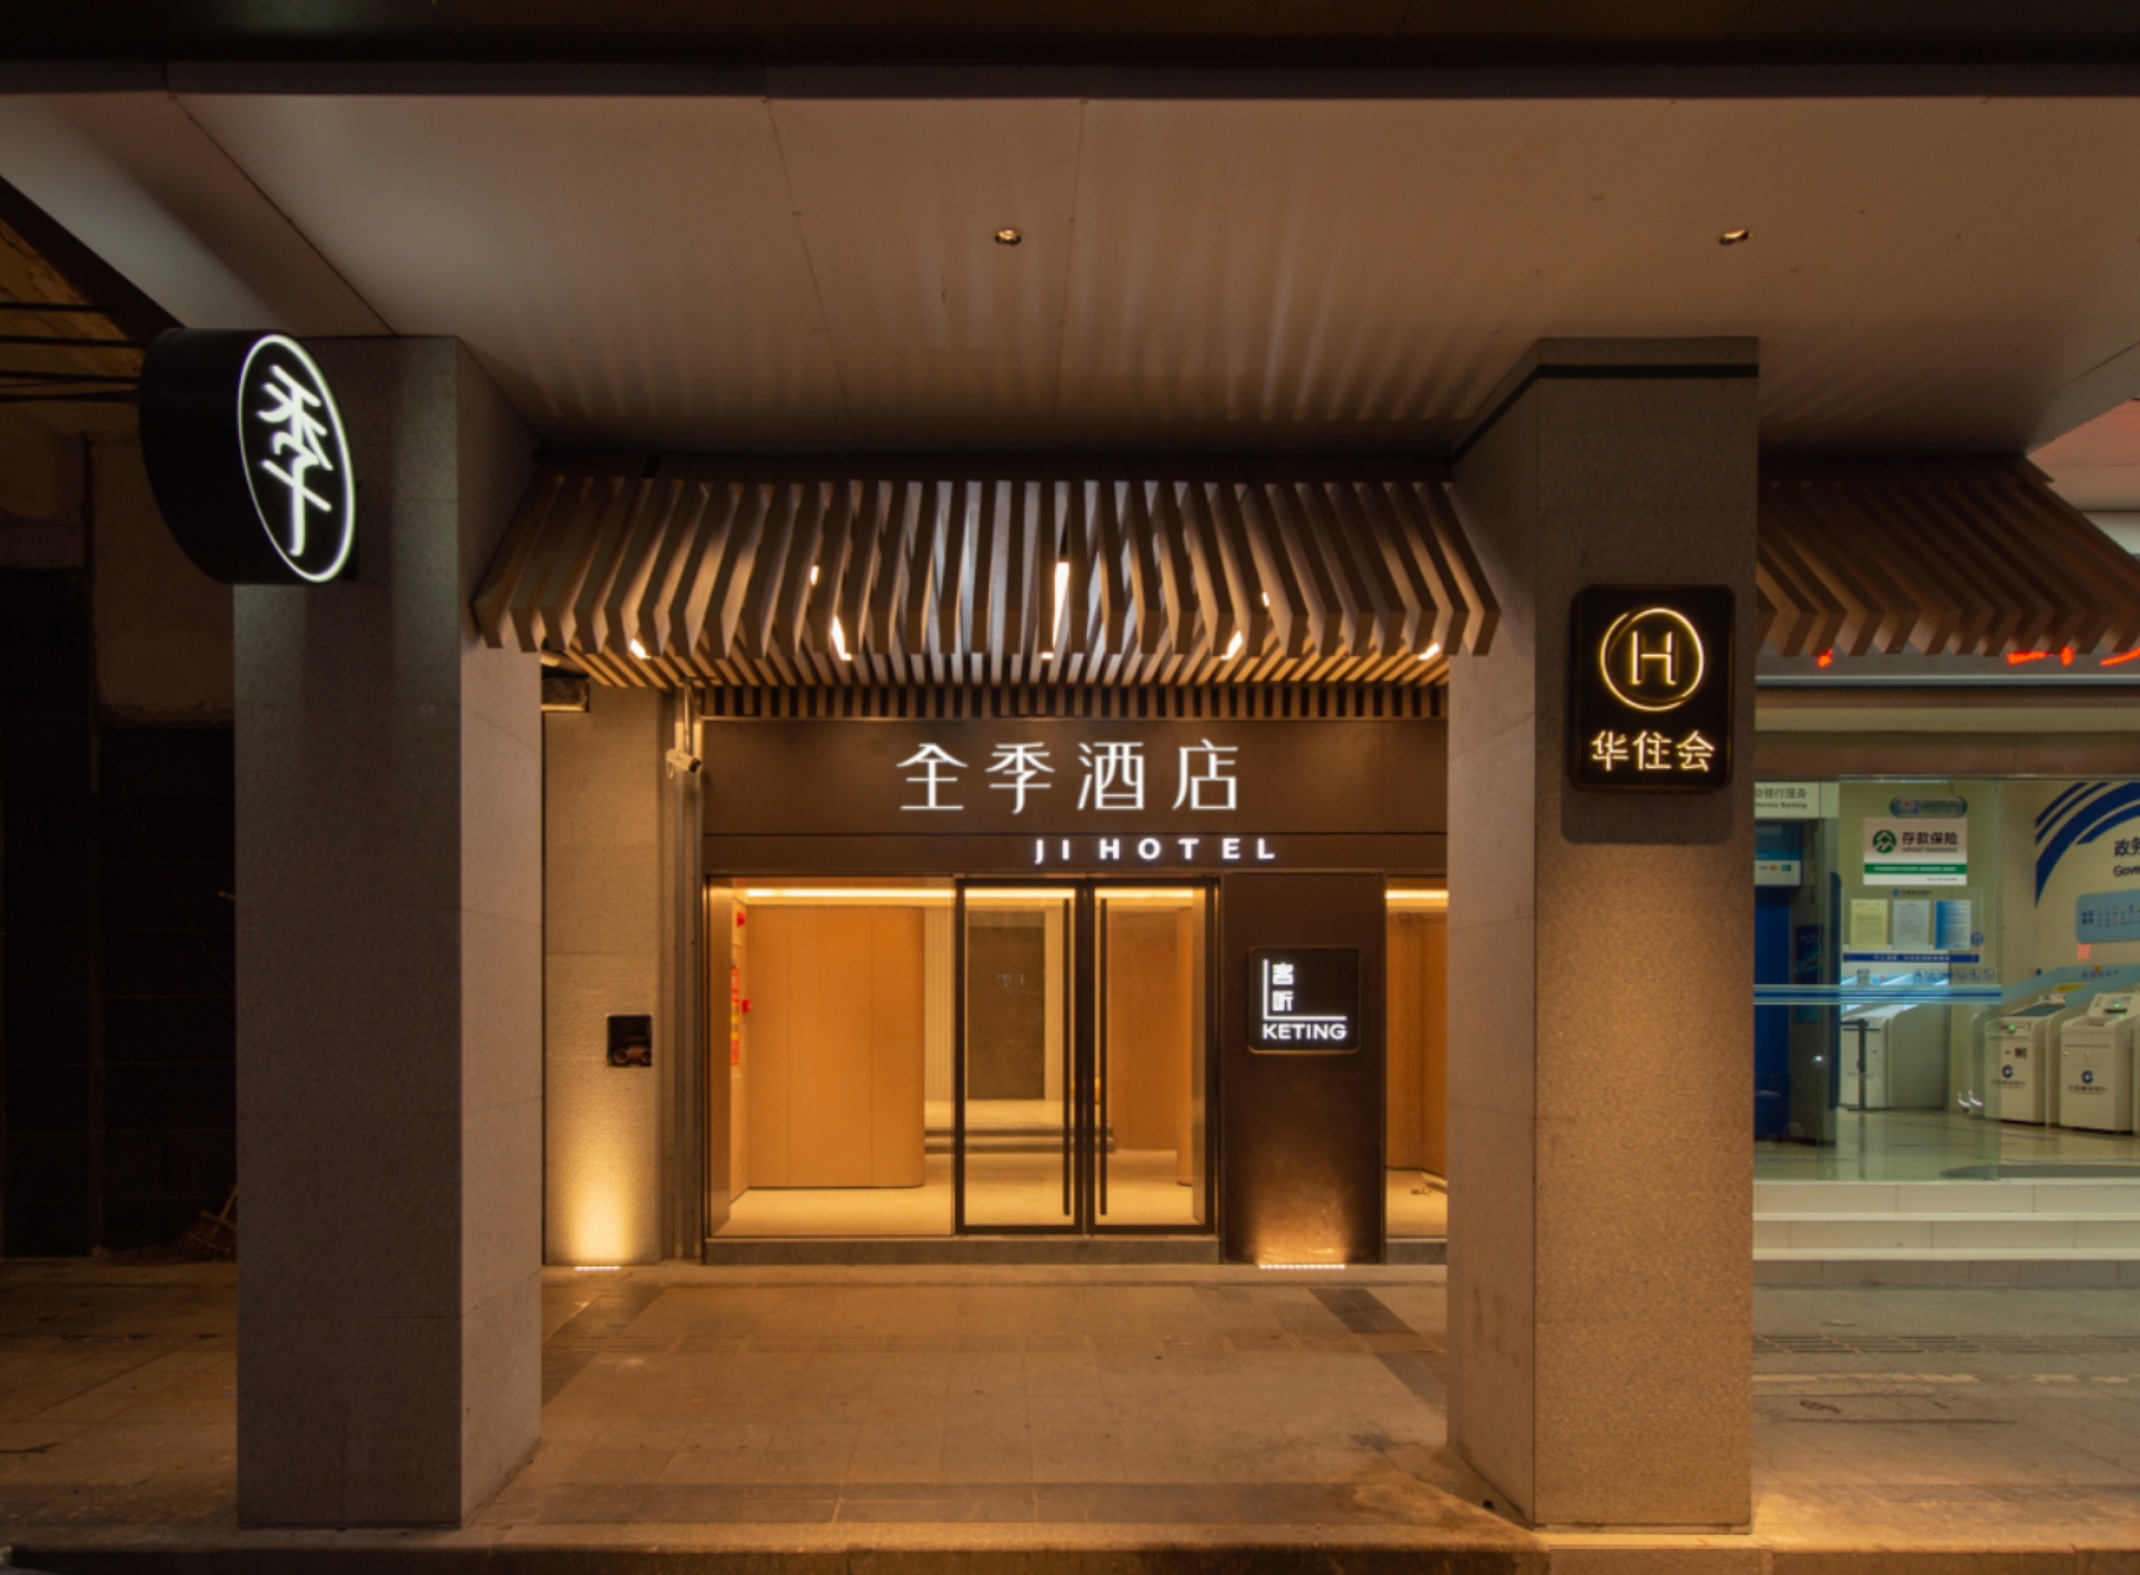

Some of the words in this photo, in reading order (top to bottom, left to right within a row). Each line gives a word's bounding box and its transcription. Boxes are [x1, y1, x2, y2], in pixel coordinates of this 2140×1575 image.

[1591, 729, 1716, 772] 华住会
[896, 738, 1239, 814] 全季酒店
[1034, 838, 1070, 865] JI
[1099, 837, 1276, 861] HOTEL
[1902, 831, 1958, 846] 存款保险
[1262, 1023, 1348, 1040] KETING
